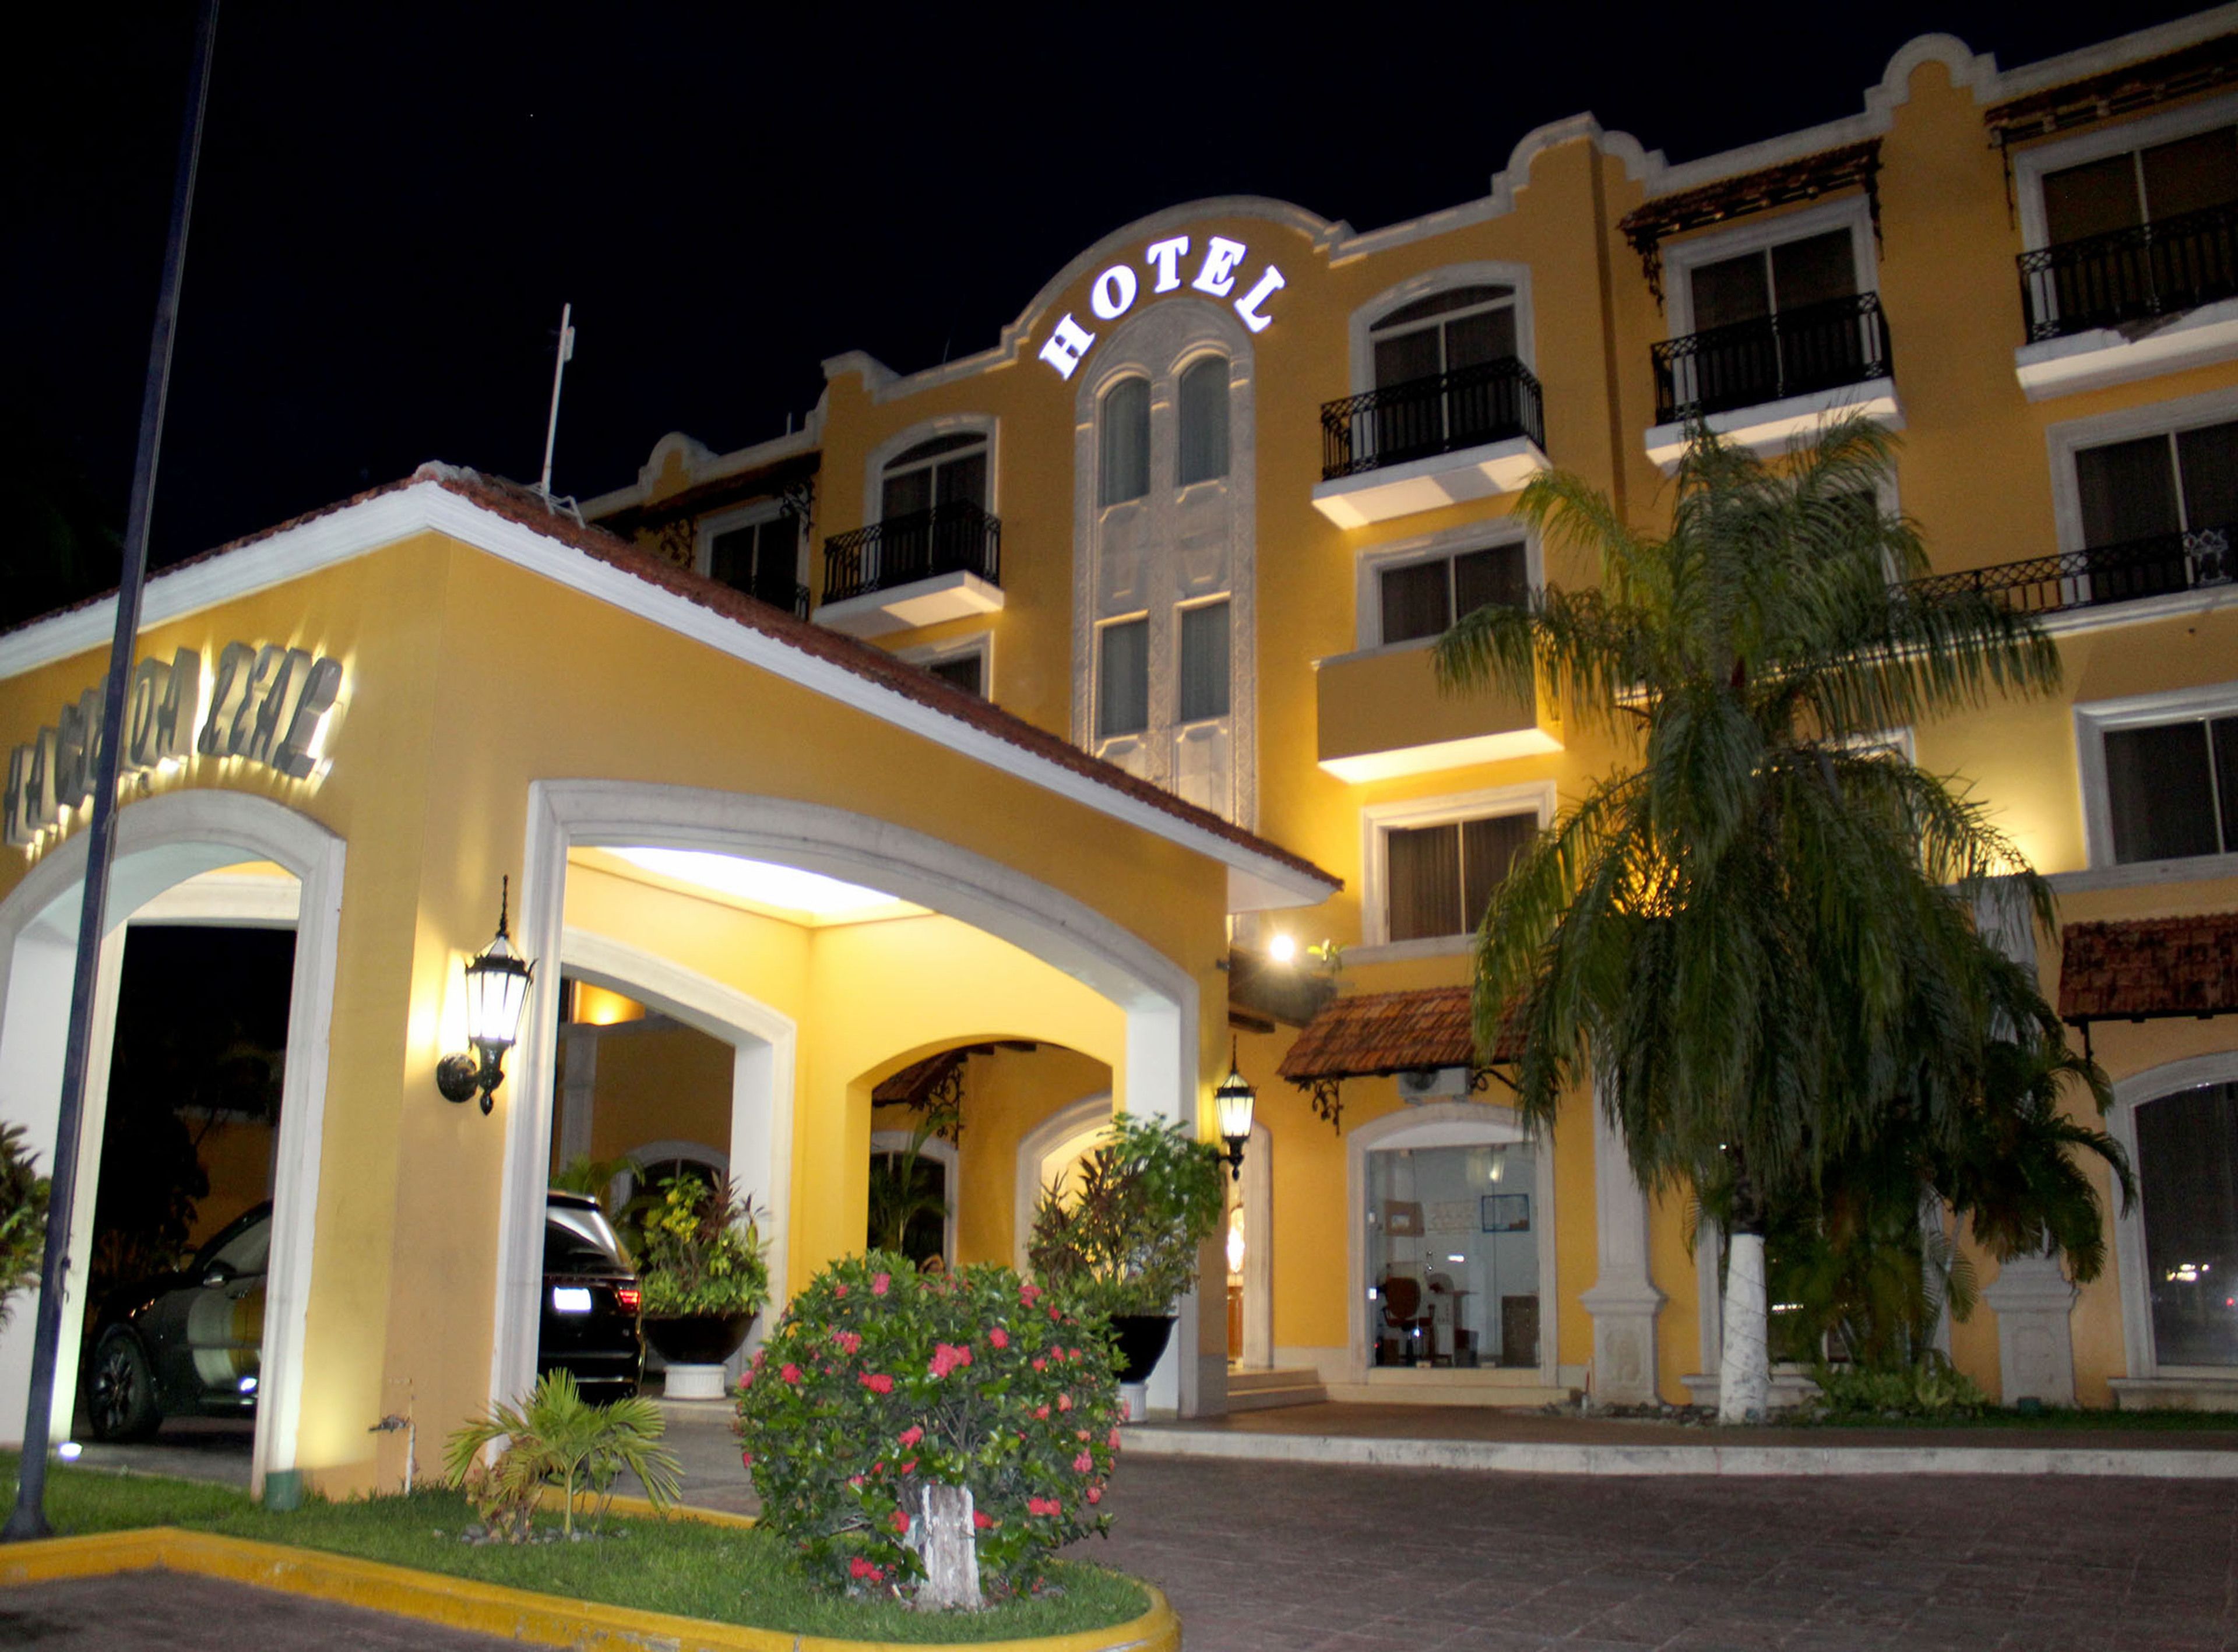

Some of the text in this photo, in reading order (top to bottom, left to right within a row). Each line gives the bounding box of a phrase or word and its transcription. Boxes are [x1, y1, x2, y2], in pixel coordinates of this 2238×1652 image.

[1038, 235, 1286, 381] HOTEL
[3, 640, 344, 847] HACIDA REAL
